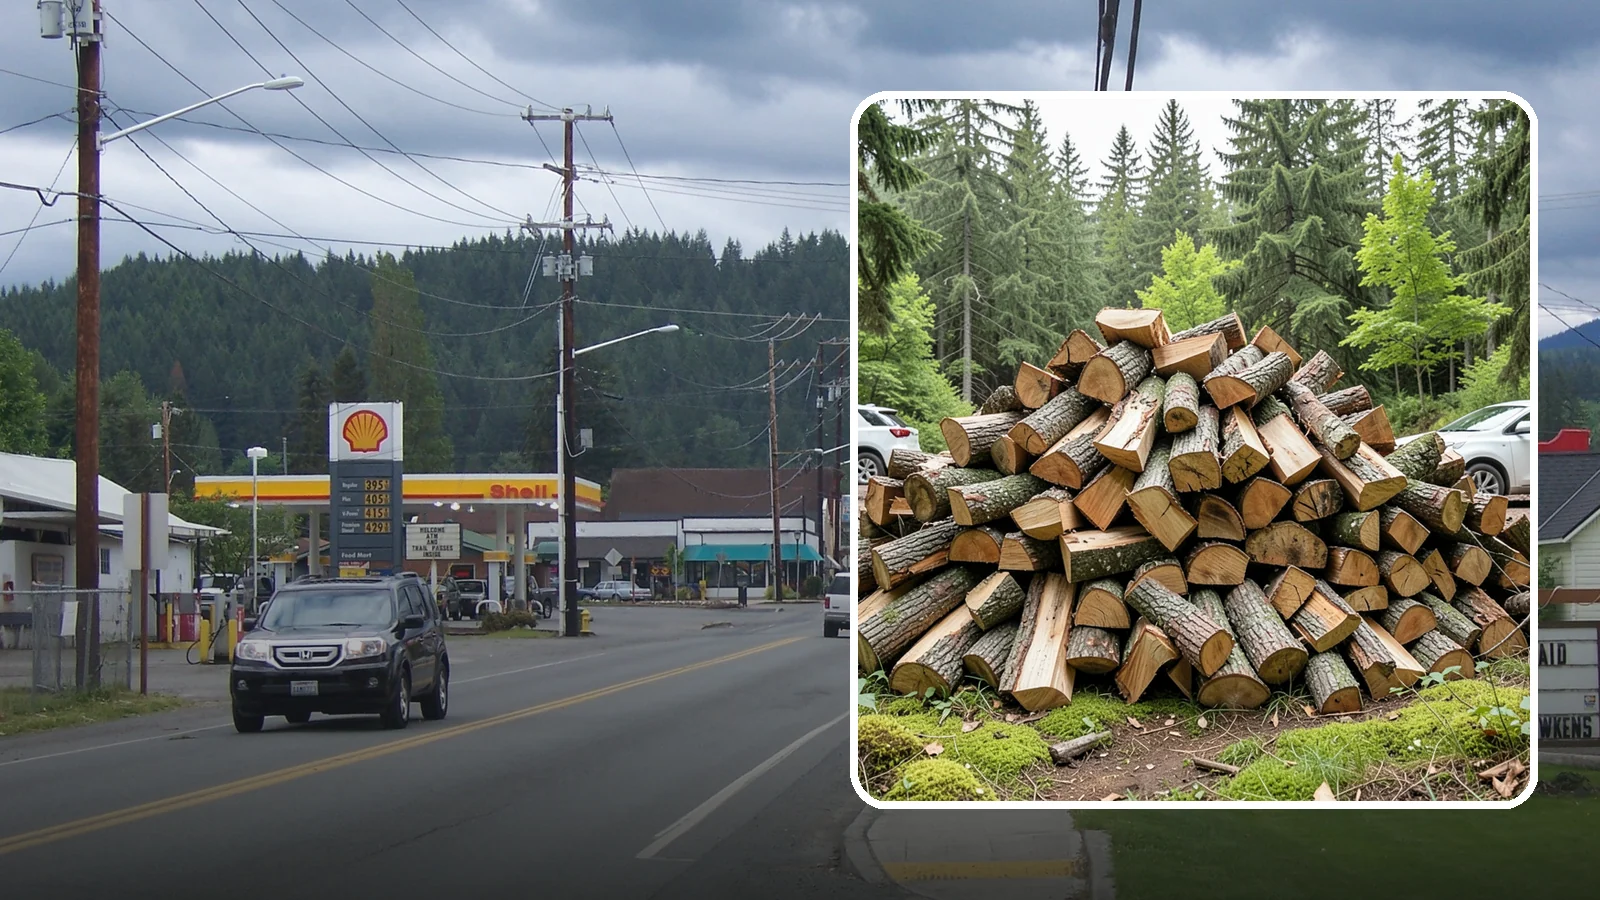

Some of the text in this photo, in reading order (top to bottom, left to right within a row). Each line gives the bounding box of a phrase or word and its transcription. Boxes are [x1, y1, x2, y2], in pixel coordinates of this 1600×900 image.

[366, 480, 383, 490] 395
[490, 484, 547, 498] Shell
[366, 494, 383, 504] 405
[366, 508, 383, 518] 415
[366, 522, 383, 532] 429
[1538, 642, 1566, 666] AID
